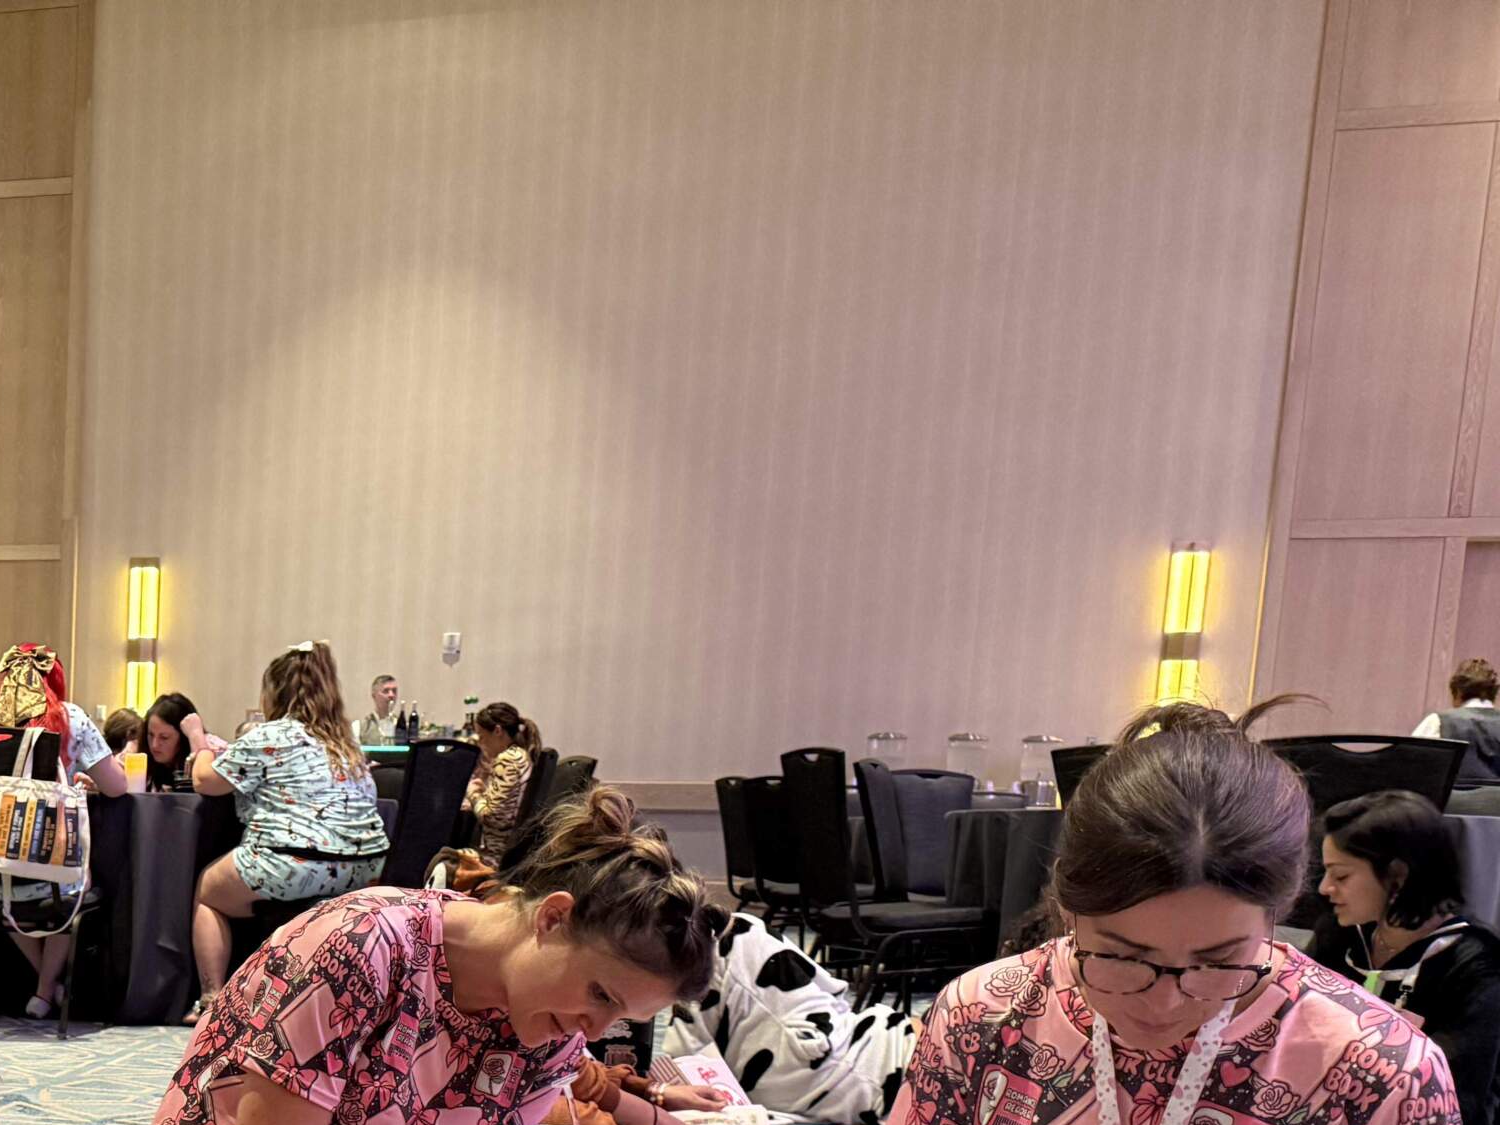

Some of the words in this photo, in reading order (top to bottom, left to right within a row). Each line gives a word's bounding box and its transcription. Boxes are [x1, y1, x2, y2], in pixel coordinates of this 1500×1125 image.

[312, 943, 350, 981] BOOK
[346, 973, 377, 1008] CLUB
[1323, 1066, 1381, 1113] BOOK
